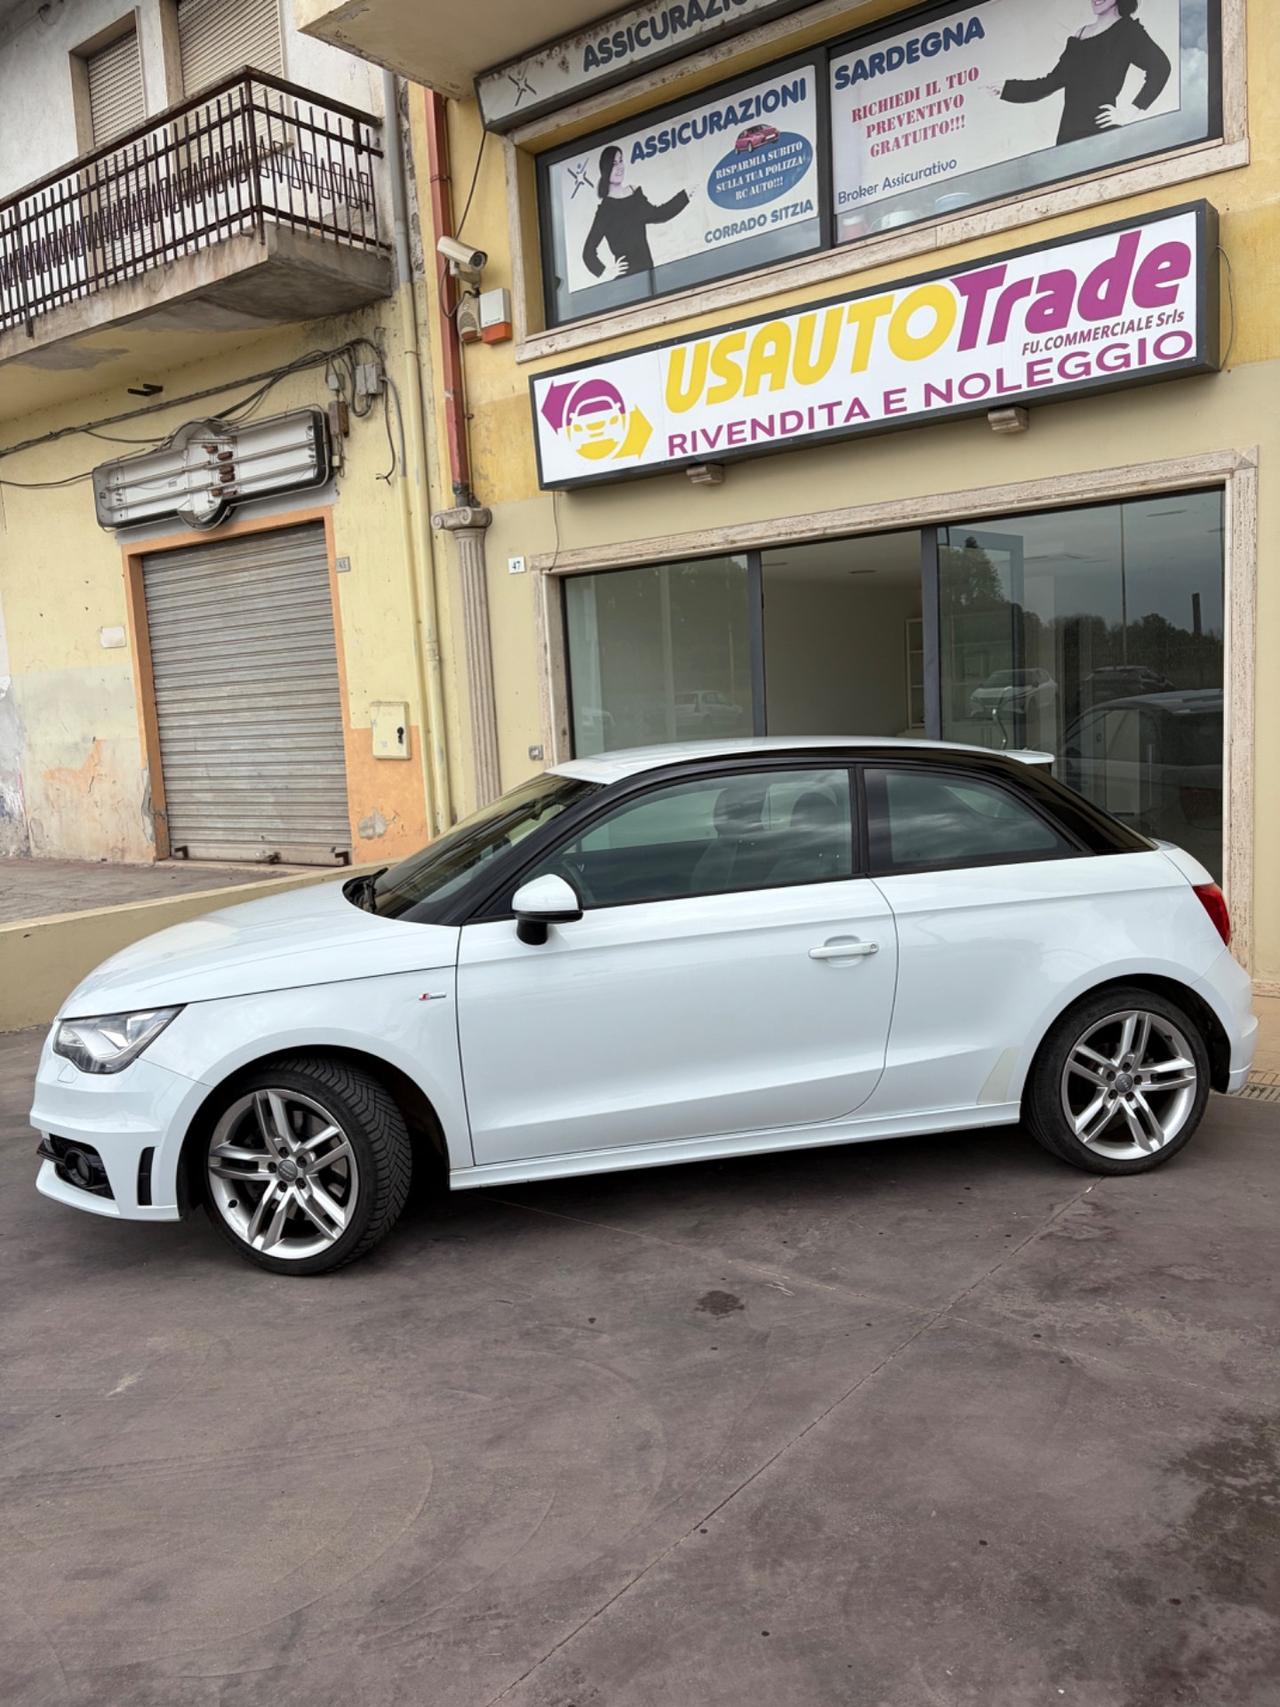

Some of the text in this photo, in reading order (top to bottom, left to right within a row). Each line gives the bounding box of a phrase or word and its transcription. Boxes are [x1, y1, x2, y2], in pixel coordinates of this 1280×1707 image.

[834, 16, 986, 91] SARDEGNA
[851, 66, 980, 123] RICHIEDI IL TUO
[865, 93, 965, 139] PREVENTIVO
[630, 77, 807, 165] ASSICURAZIONI
[869, 114, 967, 158] GRATUITO!!!
[715, 141, 803, 179] RISPARMIA SUBITO
[715, 175, 744, 193] SULLA
[745, 169, 764, 183] TUA
[838, 158, 958, 205] Broker Assicurativo
[735, 176, 784, 200] RC AUTO!!!
[704, 199, 814, 243] CORRADO SITZIA
[1155, 309, 1185, 328] Srls
[667, 330, 1194, 457] RIVENDITA E NOLEGGIO
